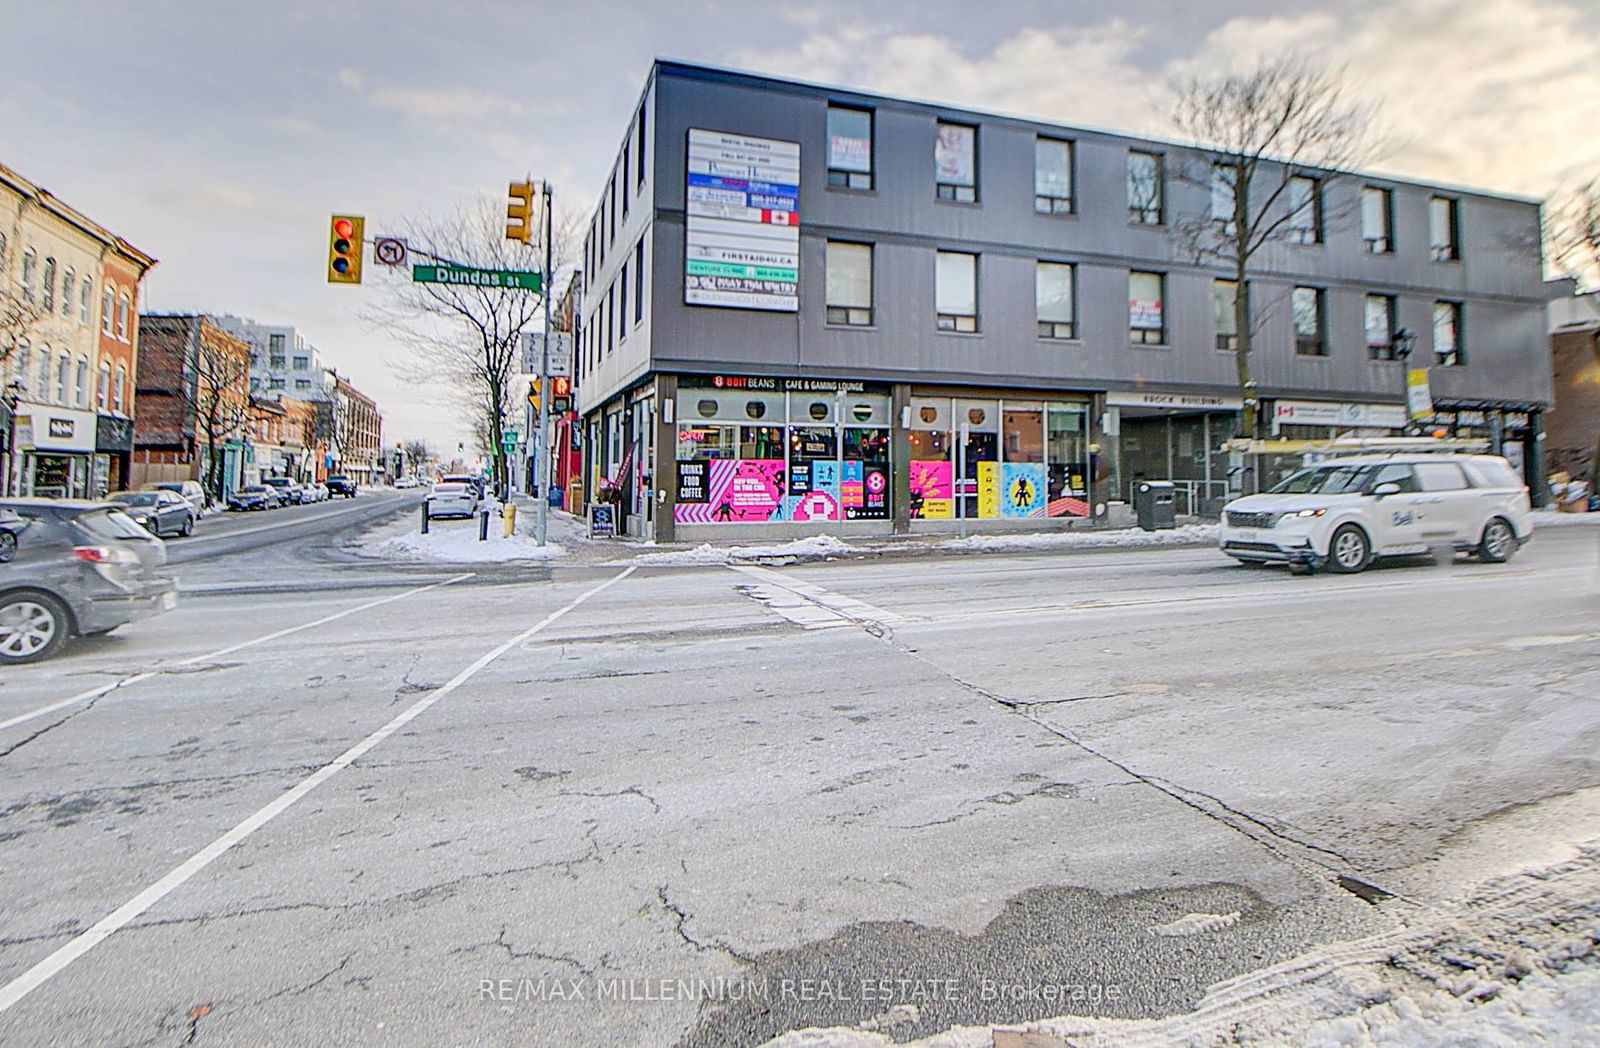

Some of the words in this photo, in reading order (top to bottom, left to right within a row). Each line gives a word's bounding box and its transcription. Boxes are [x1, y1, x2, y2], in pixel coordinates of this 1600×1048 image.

[436, 267, 501, 286] Dundas
[748, 377, 775, 388] BEANS
[810, 381, 838, 391] GAMING
[680, 464, 703, 475] DRINKS
[683, 476, 700, 486] FOOD
[680, 487, 703, 499] COFFEE
